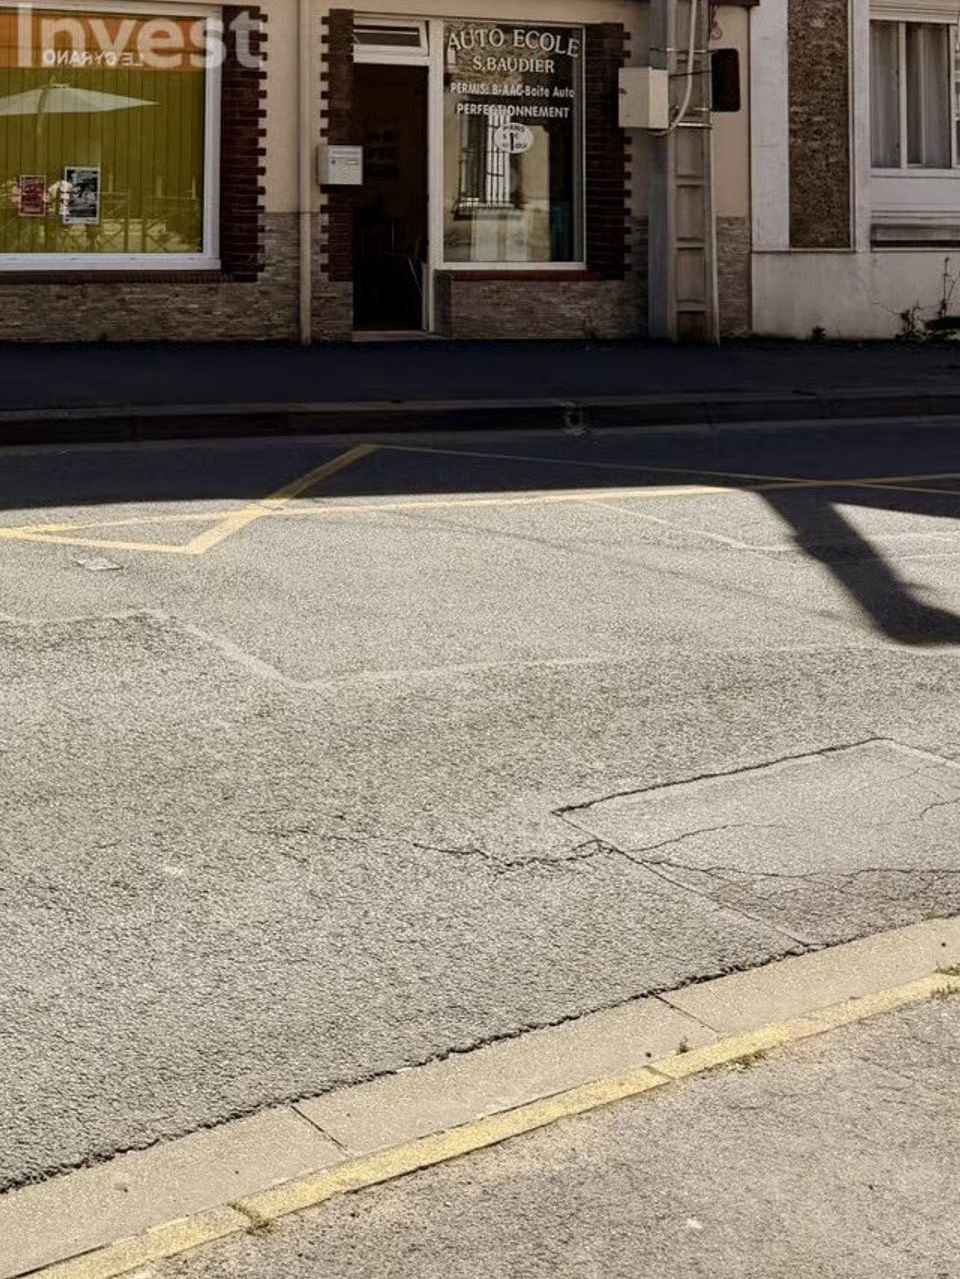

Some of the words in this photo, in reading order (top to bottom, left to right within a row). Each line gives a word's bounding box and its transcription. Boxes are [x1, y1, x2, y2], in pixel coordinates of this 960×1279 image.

[448, 27, 504, 50] AUTO
[513, 29, 580, 57] ECOLE
[552, 86, 575, 98] Auto
[457, 103, 570, 119] PERFECTIONNEMENT
